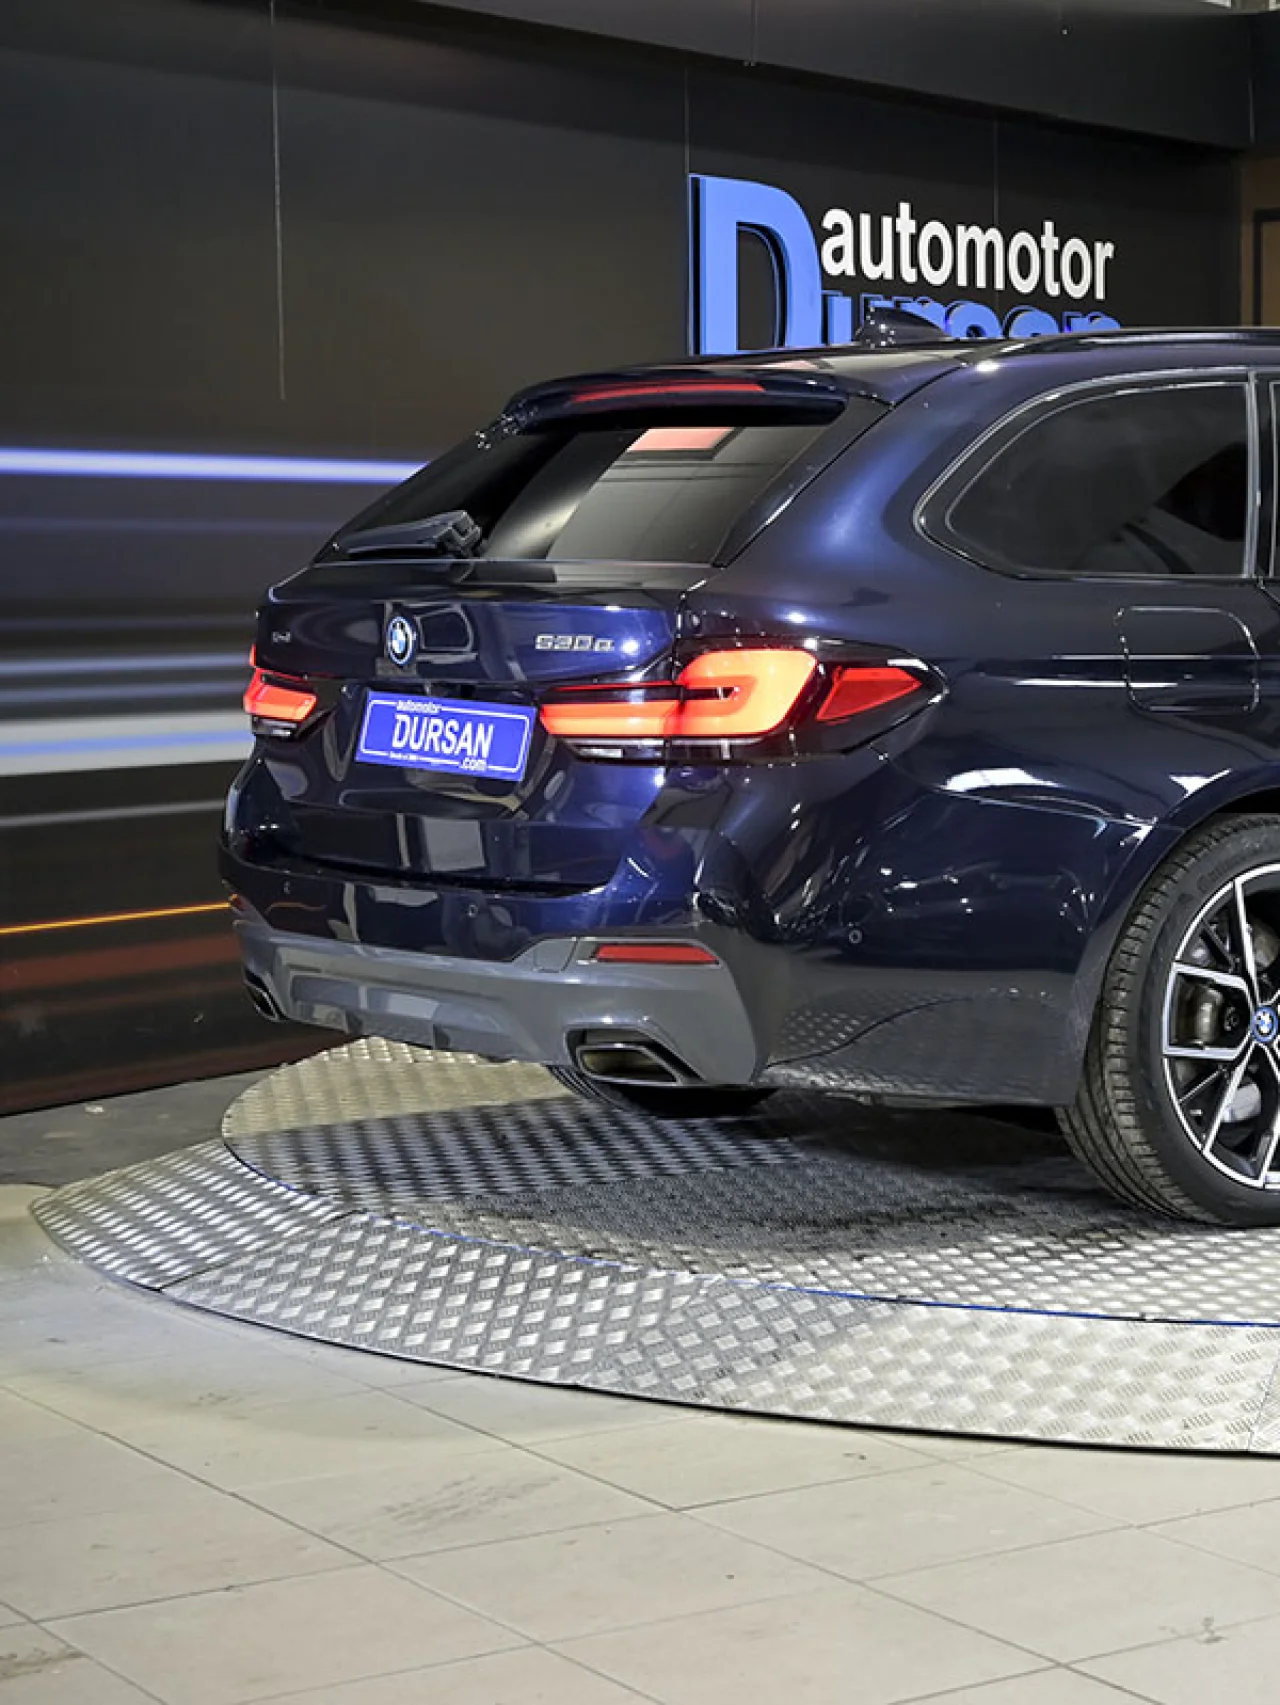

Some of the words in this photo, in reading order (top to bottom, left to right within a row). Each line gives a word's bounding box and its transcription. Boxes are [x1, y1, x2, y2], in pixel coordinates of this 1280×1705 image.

[821, 202, 1115, 300] automotor
[392, 713, 494, 758] DURSAN
[460, 757, 488, 771] .com
